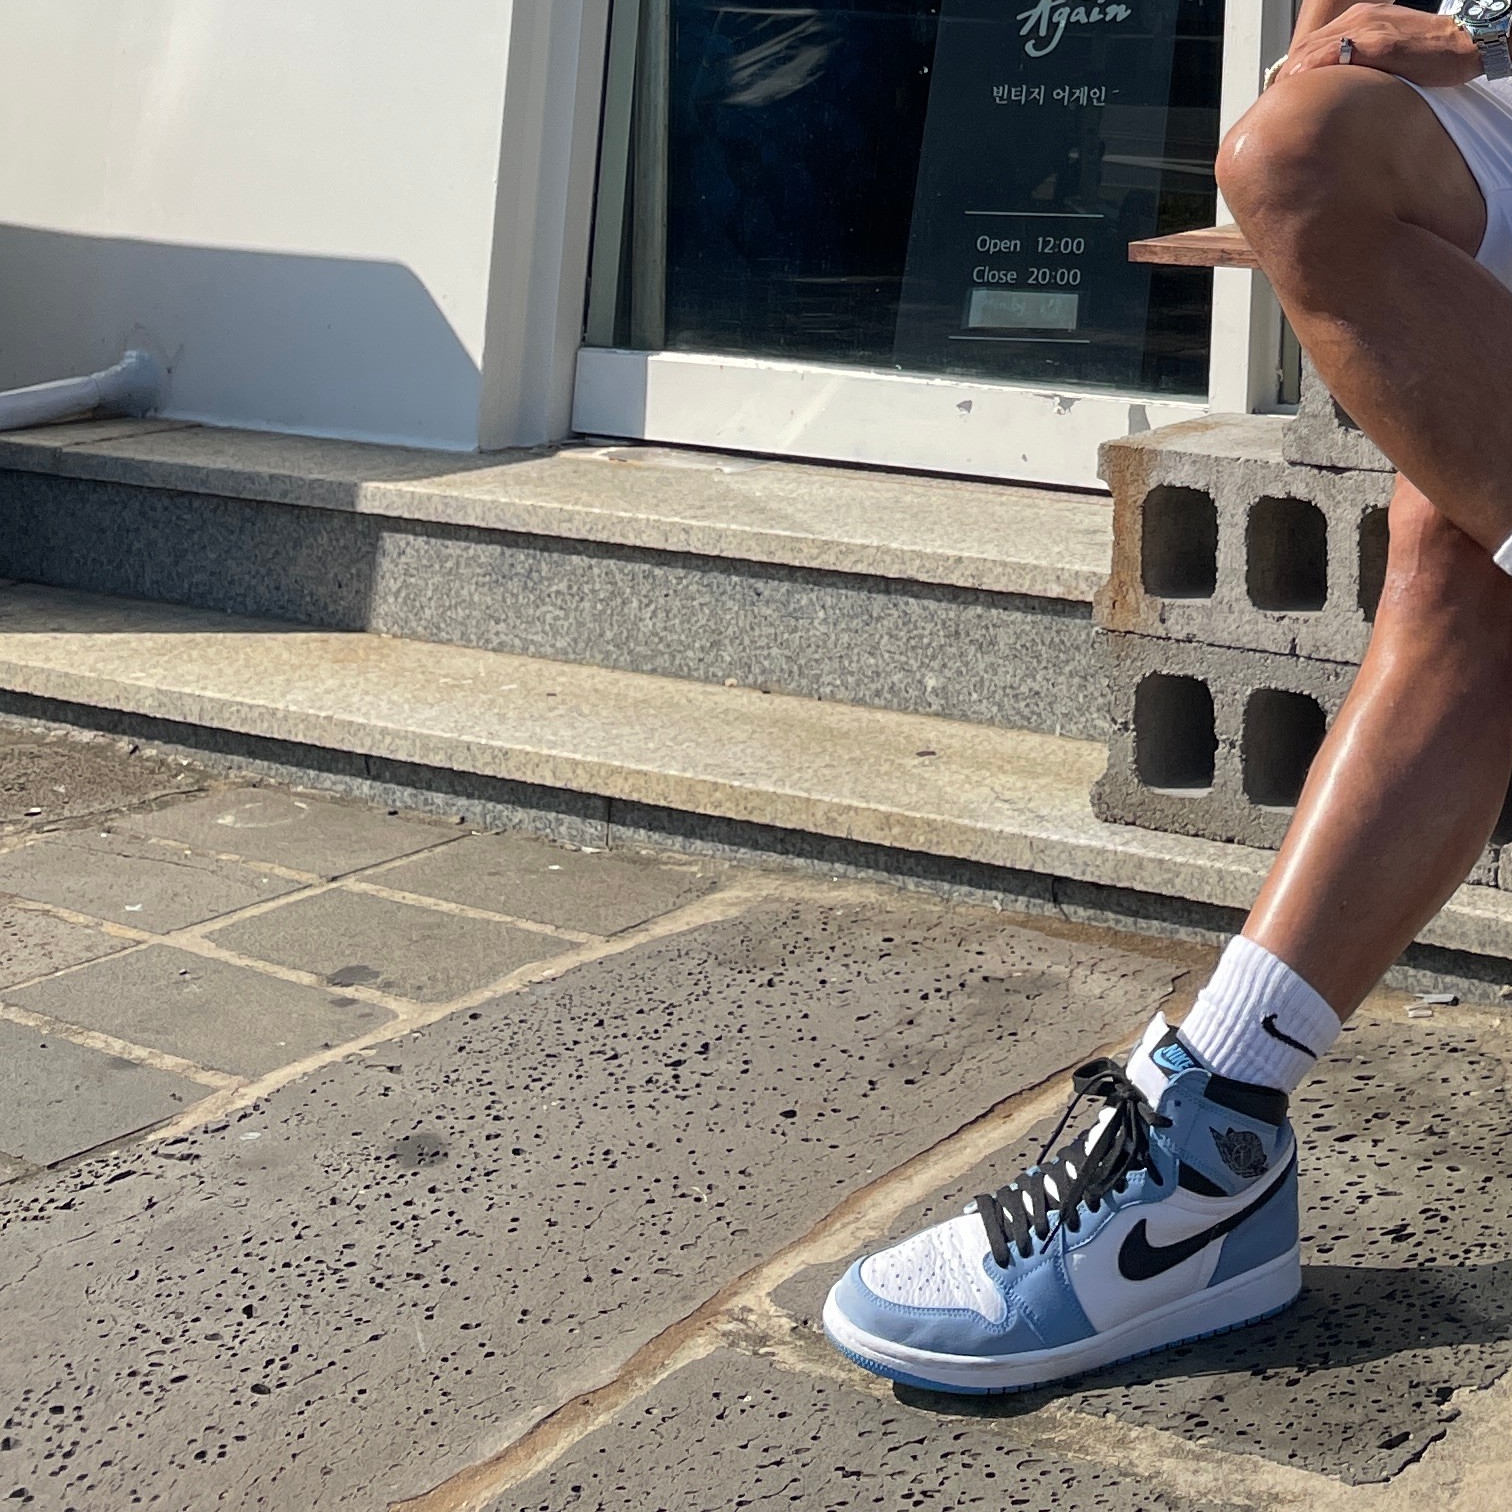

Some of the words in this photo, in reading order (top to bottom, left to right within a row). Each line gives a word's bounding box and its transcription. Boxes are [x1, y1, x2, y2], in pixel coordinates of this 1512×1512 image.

[992, 84, 1045, 105] 빈티지
[1052, 85, 1106, 106] 어게인
[976, 235, 1021, 255] Open
[1037, 236, 1085, 254] 12:00
[972, 266, 1017, 283] Close
[1027, 267, 1081, 285] 20:00
